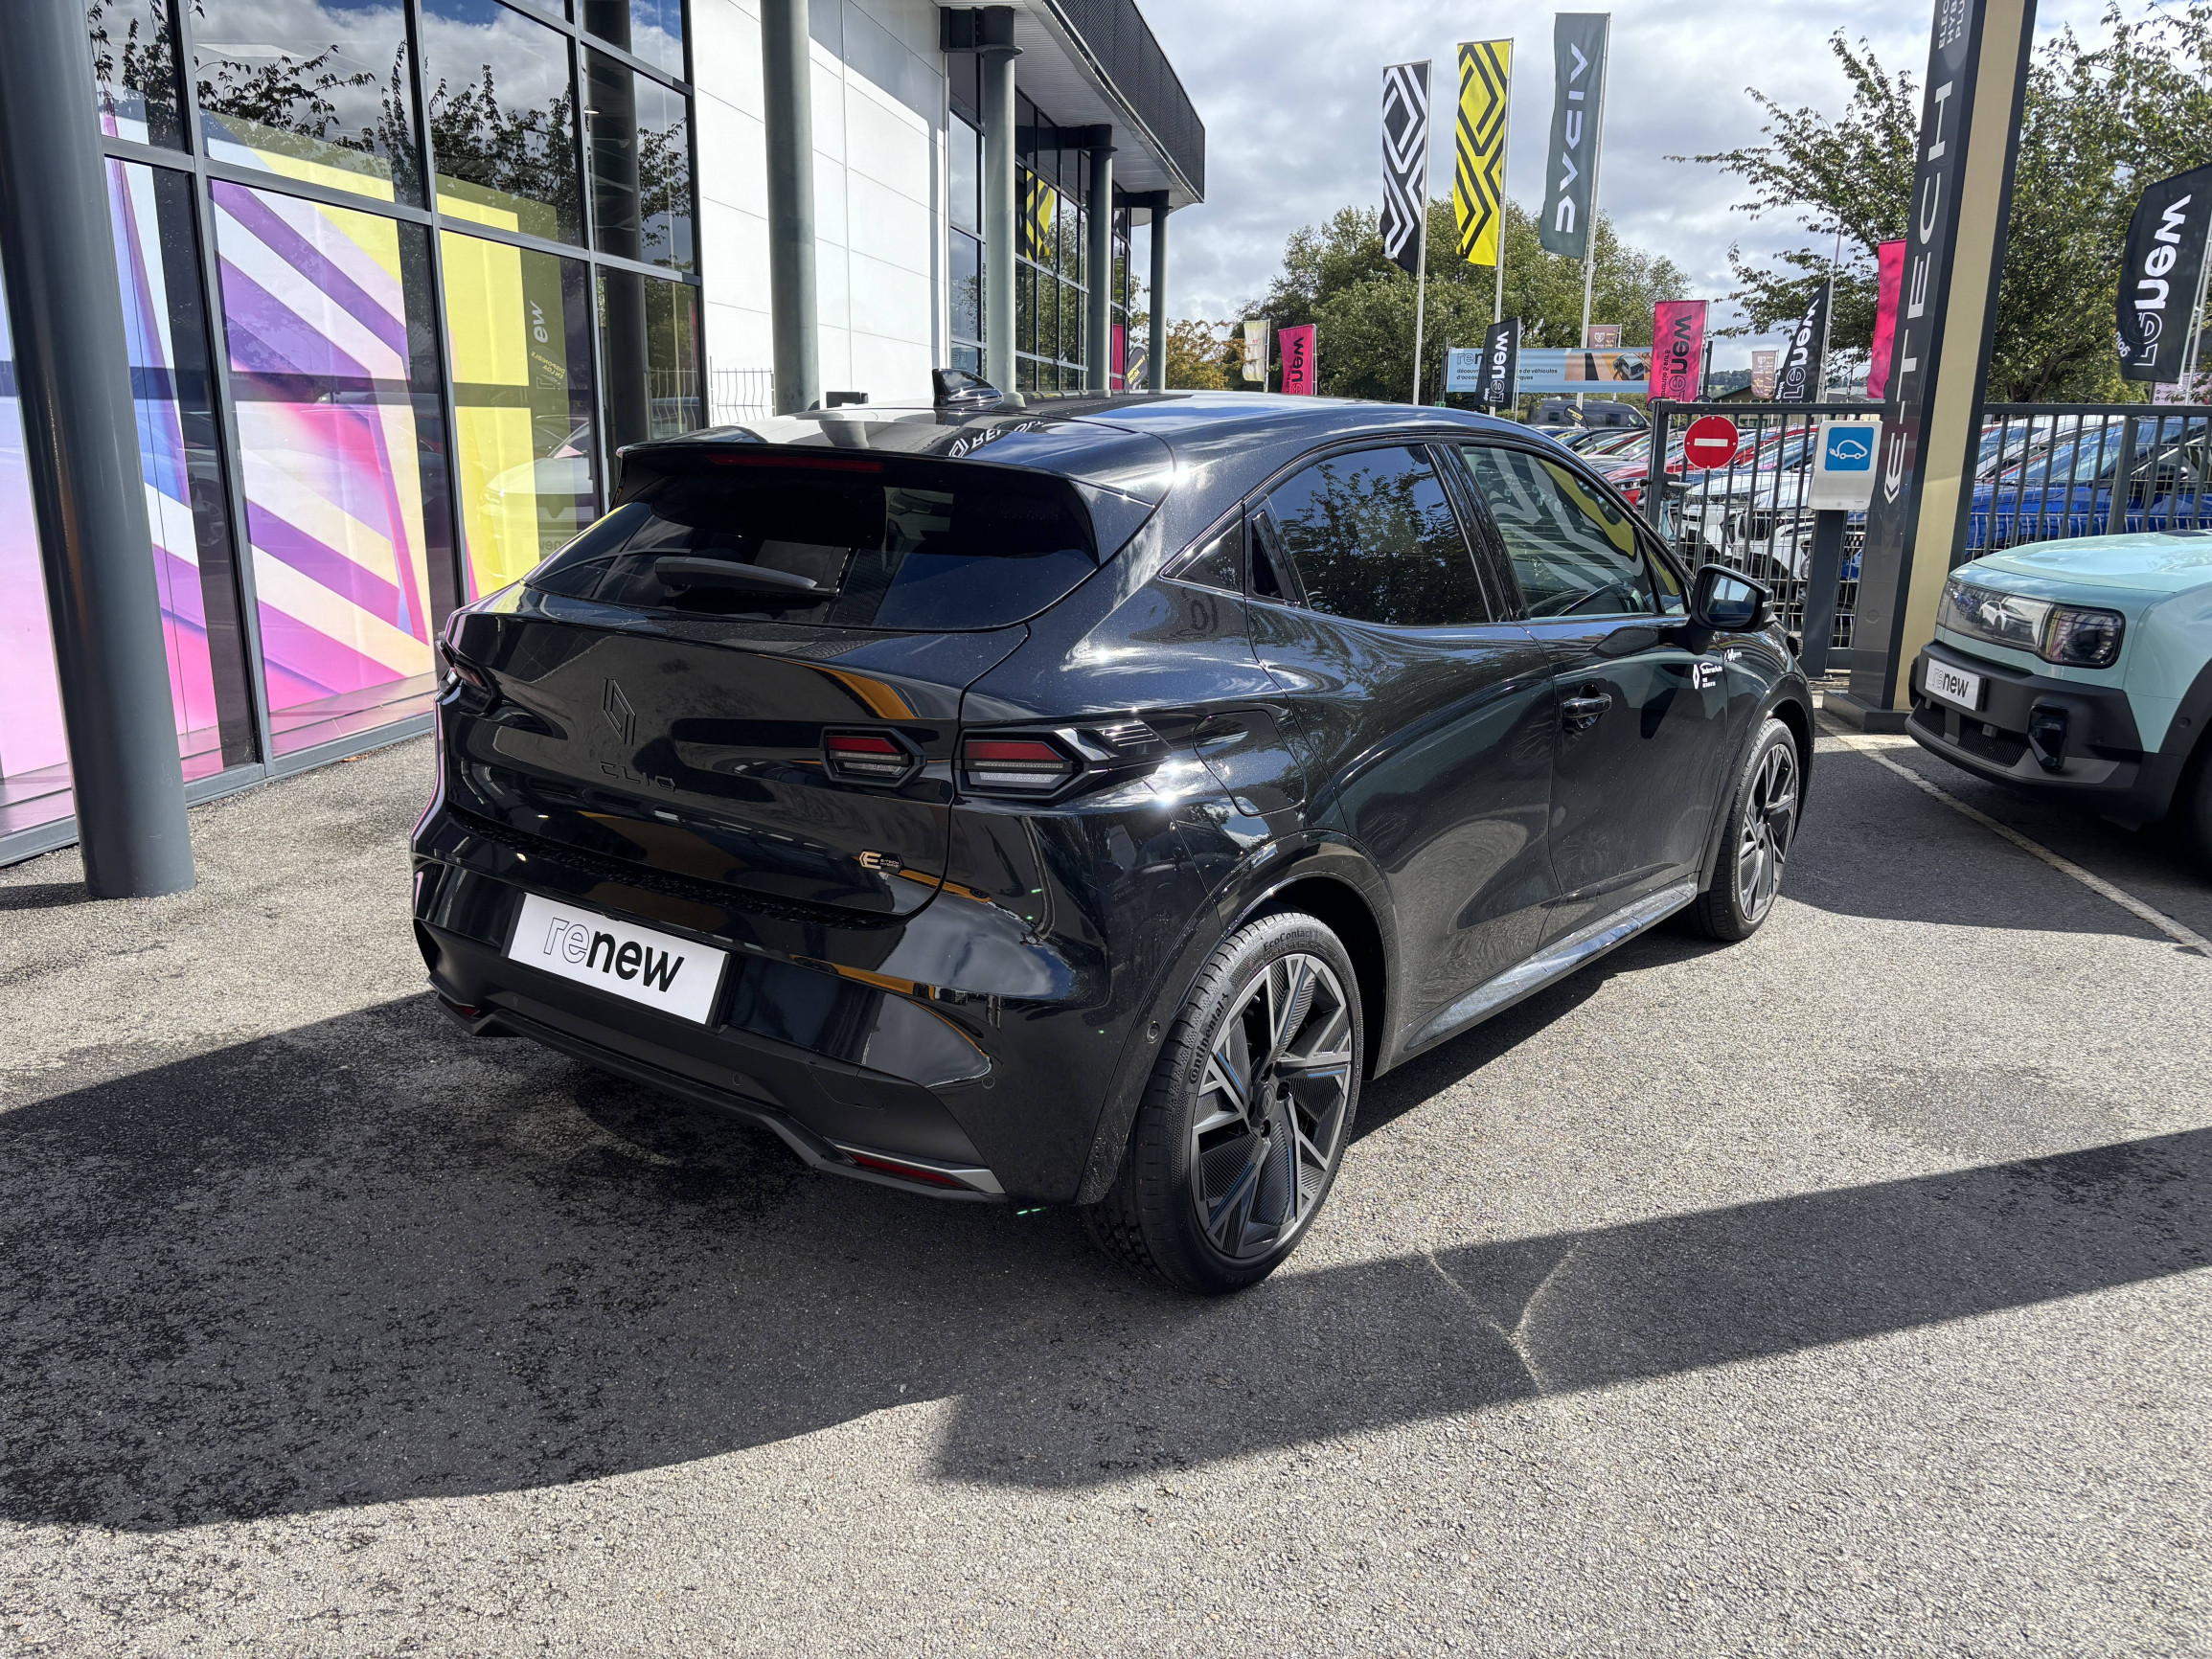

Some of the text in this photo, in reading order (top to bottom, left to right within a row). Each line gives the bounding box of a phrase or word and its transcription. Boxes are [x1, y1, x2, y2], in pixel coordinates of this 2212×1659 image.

[1932, 668, 1970, 698] renew
[598, 761, 676, 793] CLIO
[543, 917, 686, 993] renew
[1189, 1000, 1225, 1085] Continental
